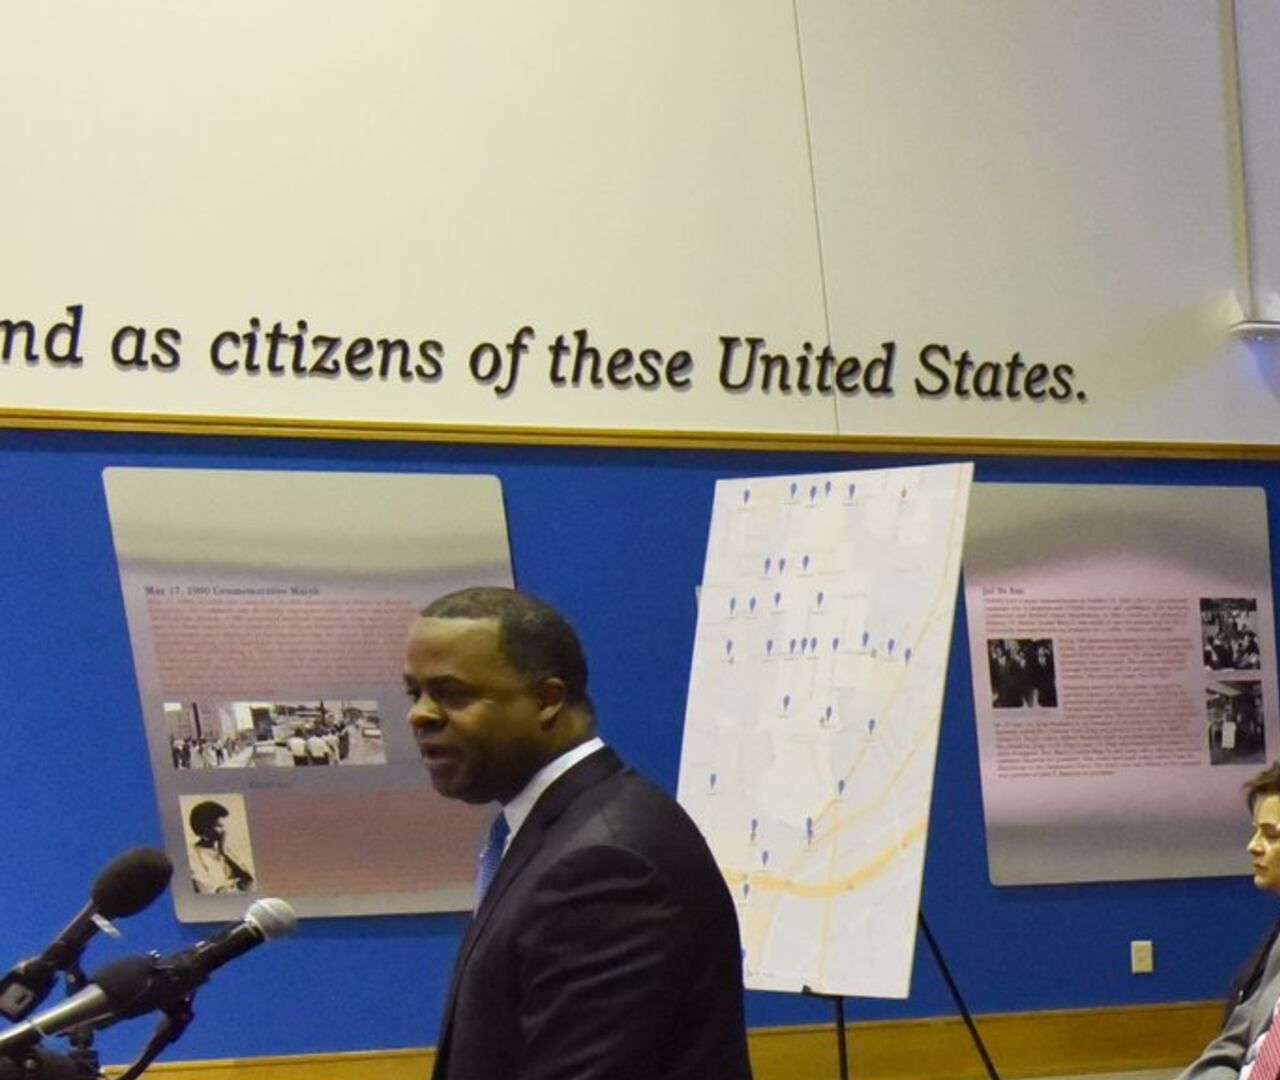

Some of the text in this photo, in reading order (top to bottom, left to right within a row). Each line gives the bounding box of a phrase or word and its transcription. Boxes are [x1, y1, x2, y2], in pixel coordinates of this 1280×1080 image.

[111, 325, 182, 369] as
[210, 317, 445, 381] citizens
[469, 326, 535, 397] of
[549, 328, 694, 390] these
[718, 335, 897, 395] United
[914, 342, 1088, 402] States.
